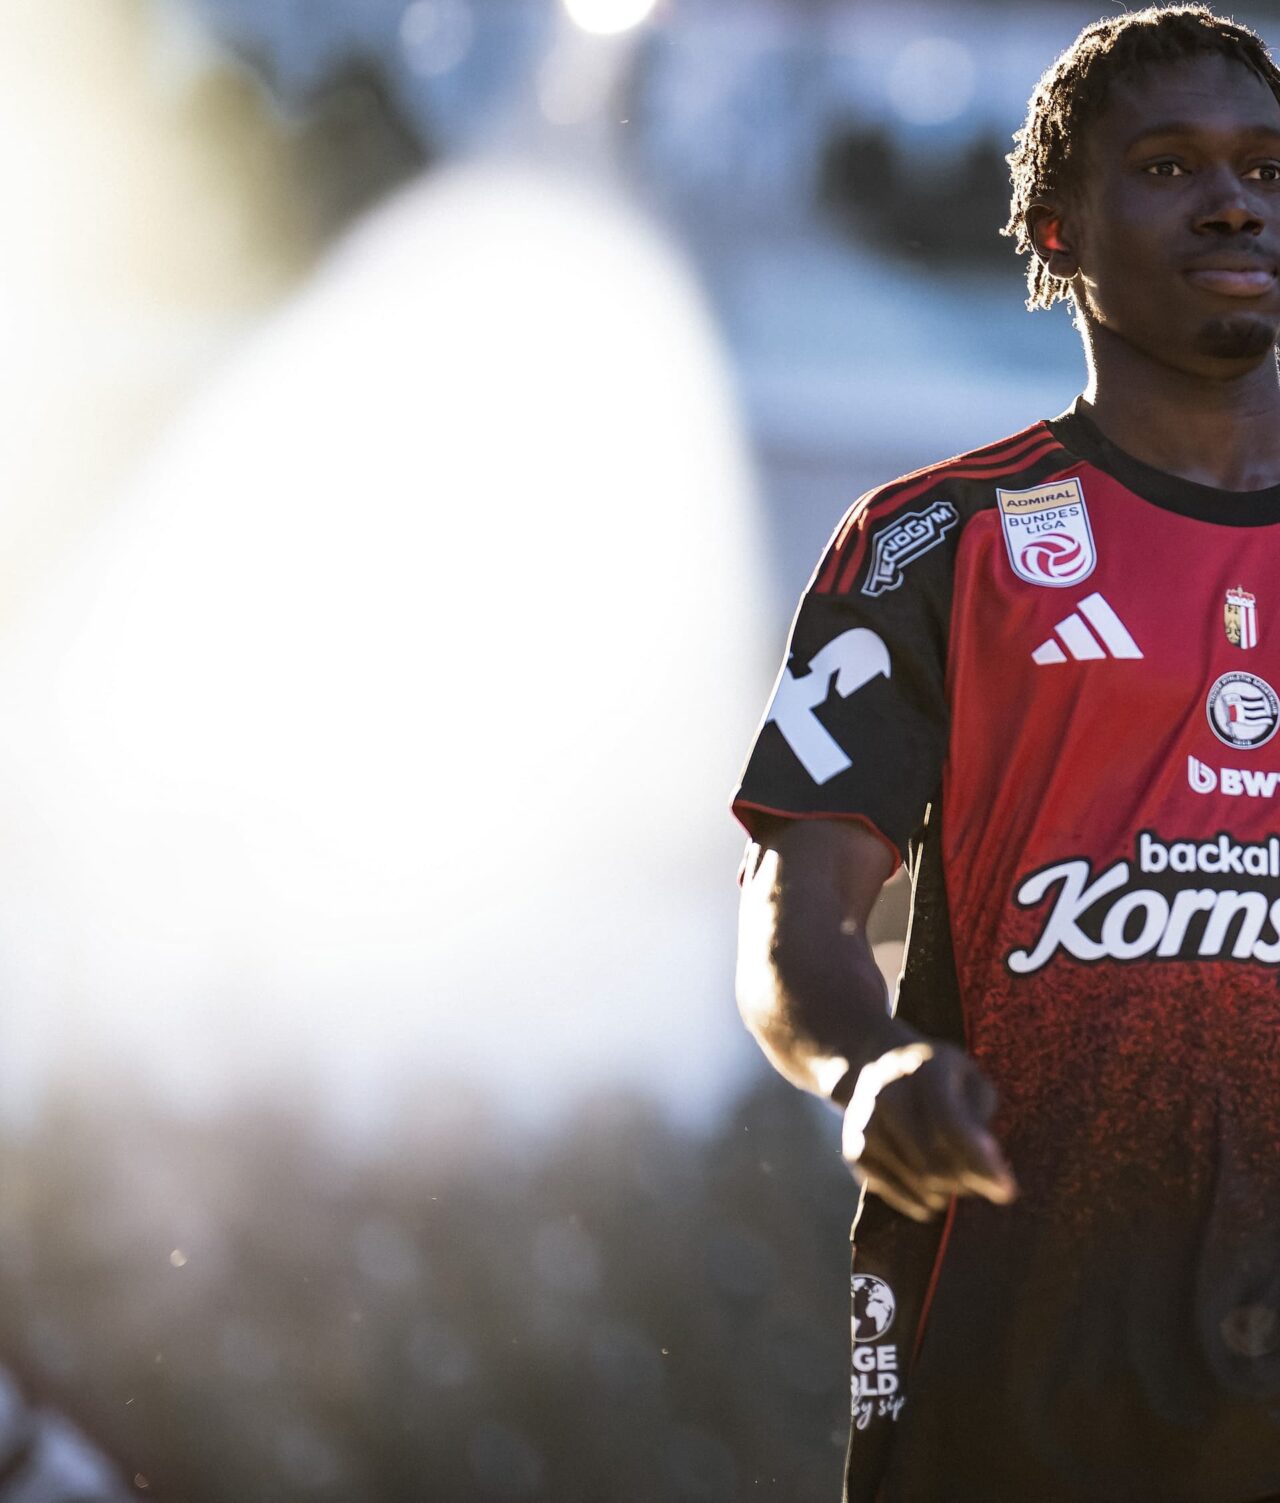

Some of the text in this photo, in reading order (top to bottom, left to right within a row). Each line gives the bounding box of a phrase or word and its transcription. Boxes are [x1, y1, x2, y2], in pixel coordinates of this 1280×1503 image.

[1006, 489, 1077, 508] ADMIRAL
[1008, 506, 1080, 528] BUNDES
[1026, 520, 1067, 535] LIGA
